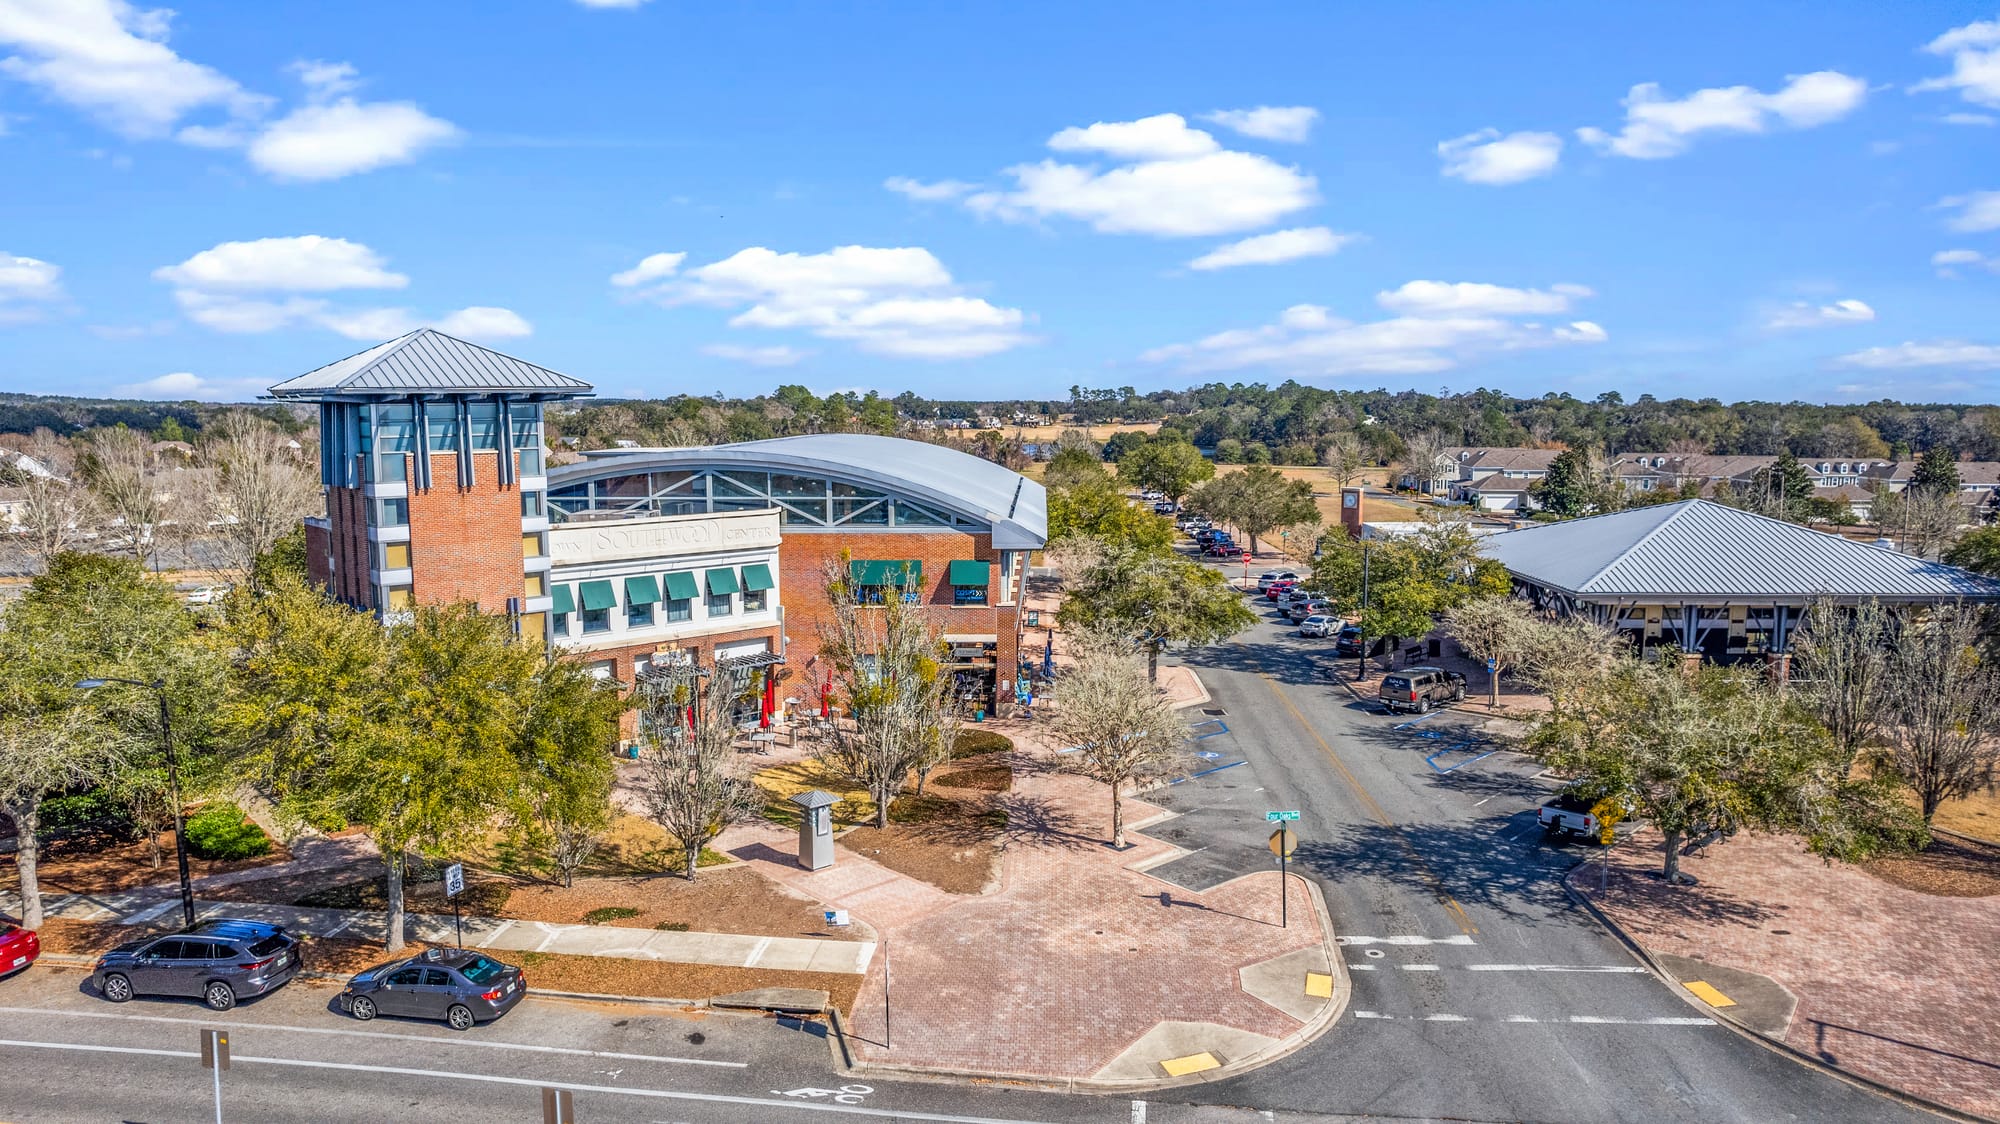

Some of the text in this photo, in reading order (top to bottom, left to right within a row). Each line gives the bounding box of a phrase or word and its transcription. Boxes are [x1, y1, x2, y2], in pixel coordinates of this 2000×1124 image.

[596, 520, 720, 551] SOUTHWOOD
[726, 527, 772, 540] CENTER
[450, 878, 461, 891] 35
